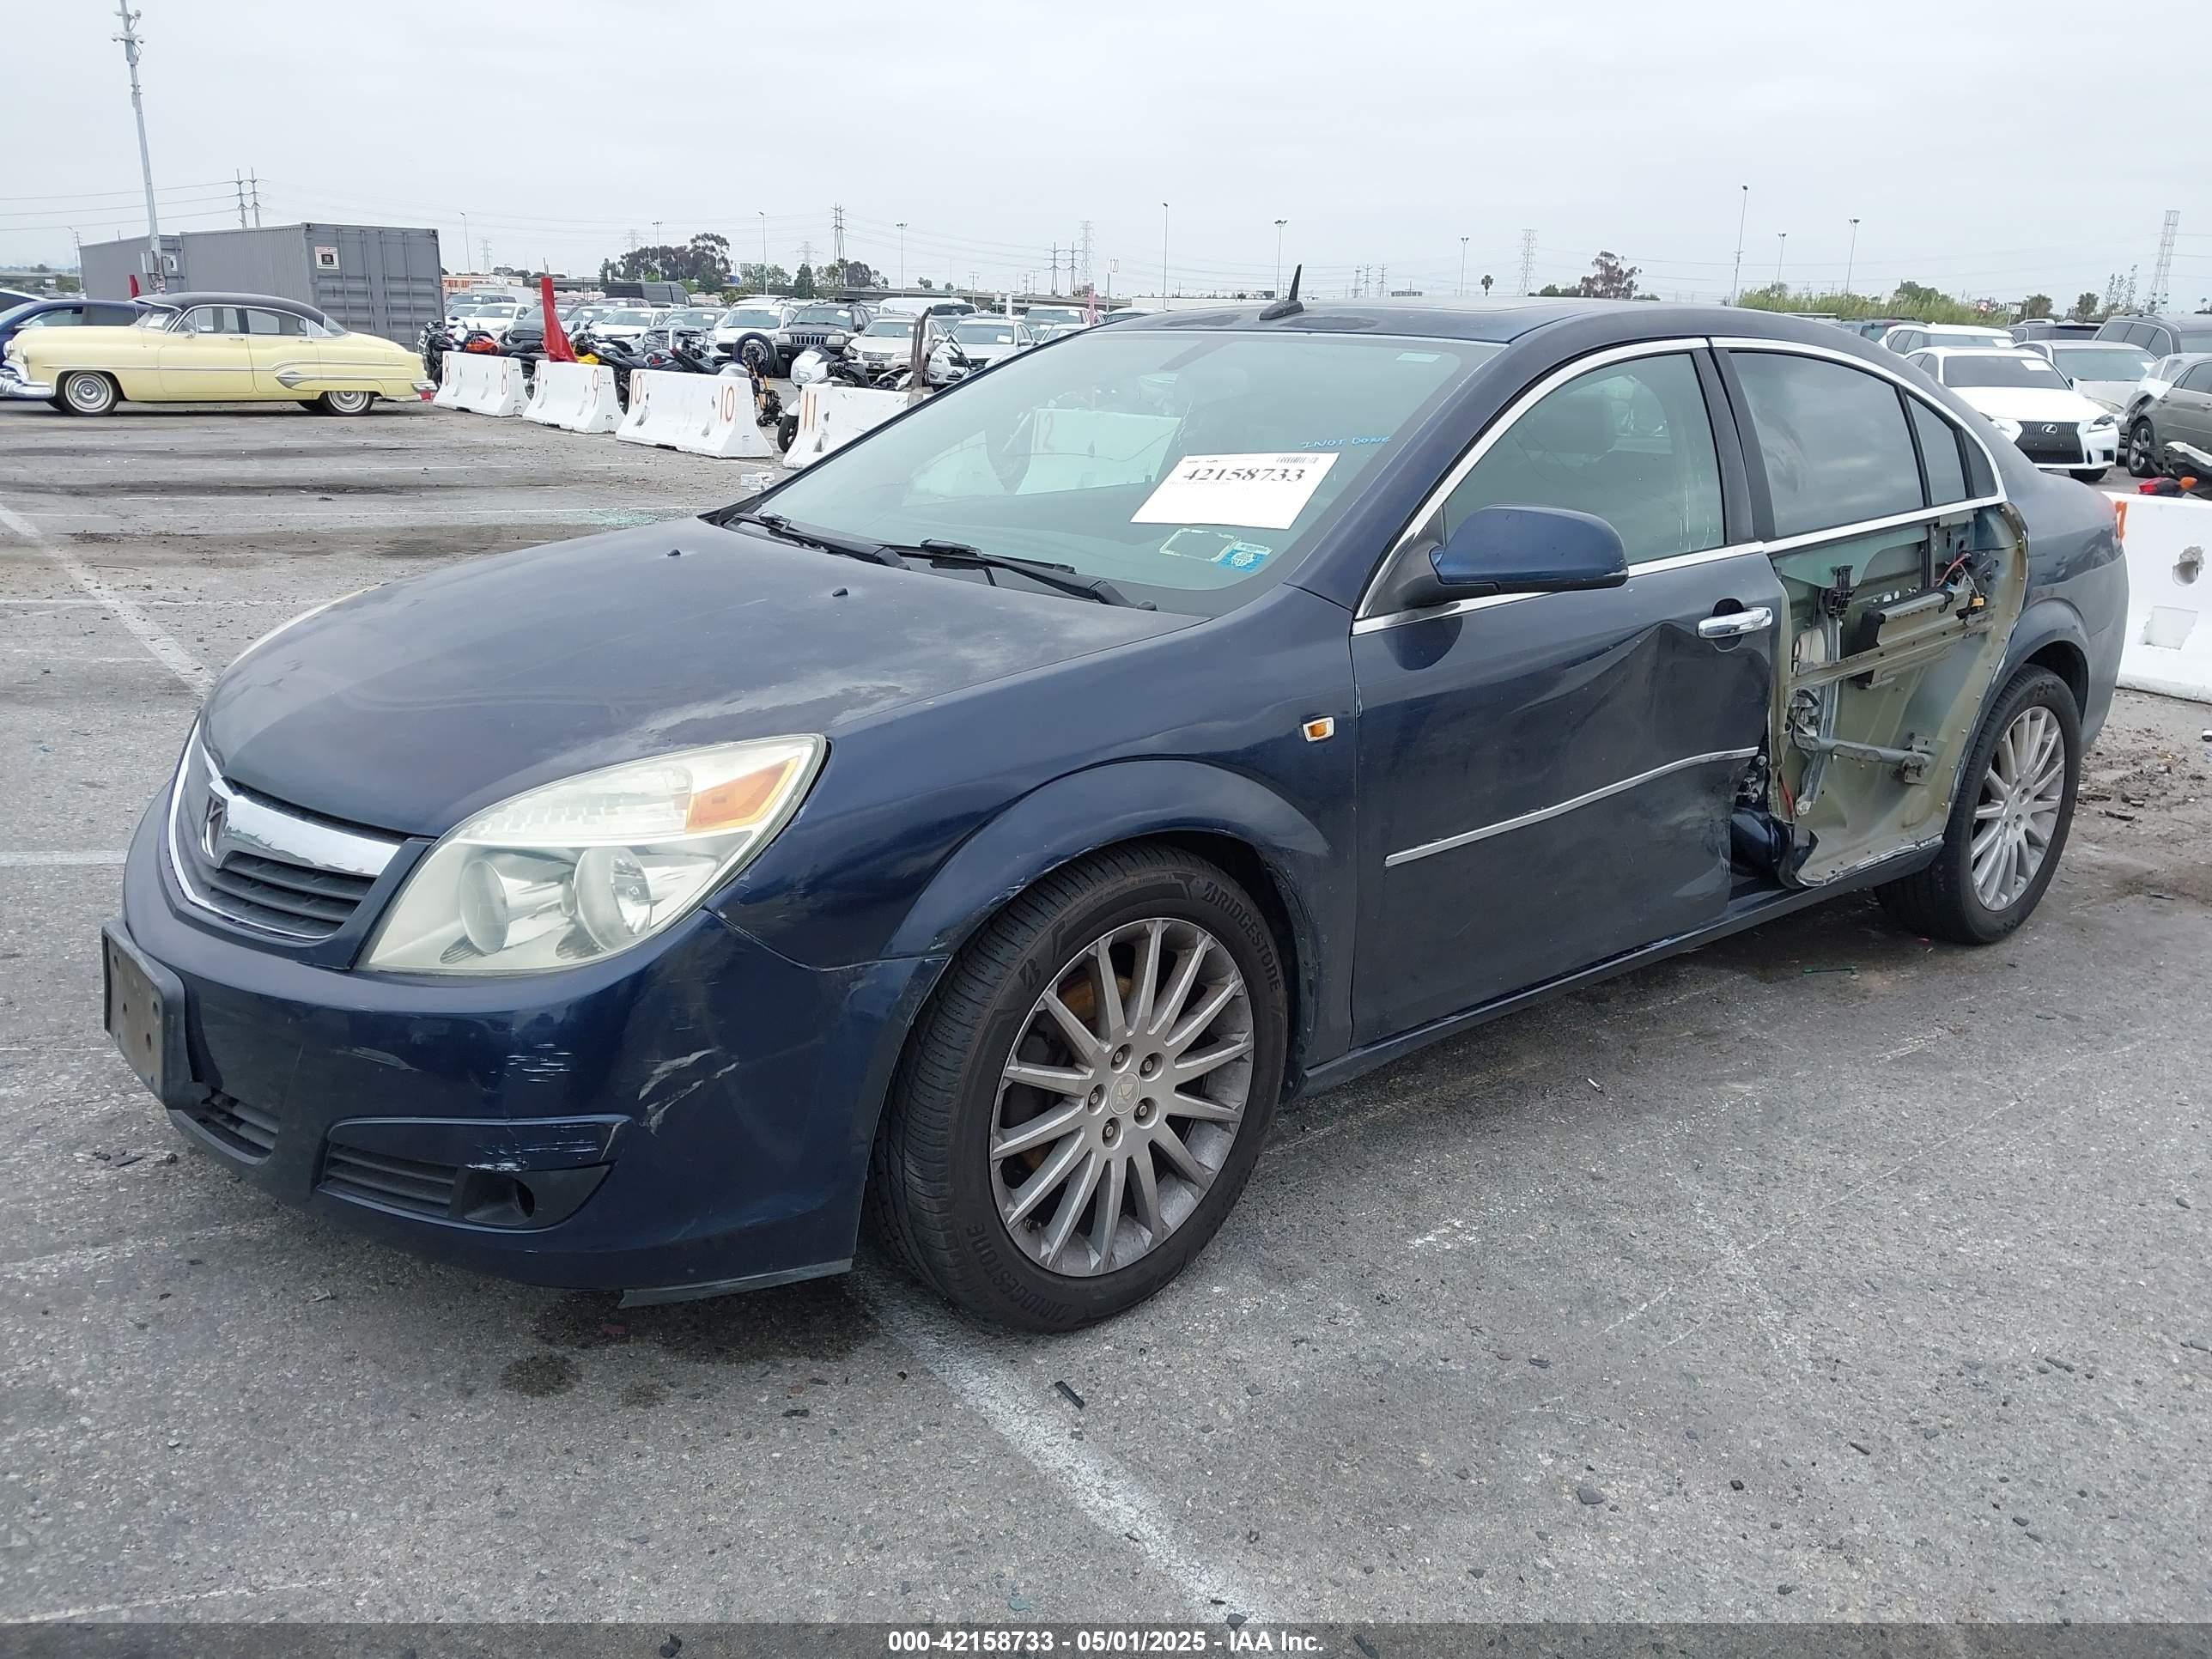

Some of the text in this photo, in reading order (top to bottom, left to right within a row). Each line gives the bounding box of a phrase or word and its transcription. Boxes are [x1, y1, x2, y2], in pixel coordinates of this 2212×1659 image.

[501, 359, 508, 396] 8
[592, 368, 600, 408] 9
[630, 373, 643, 406] 10
[720, 385, 735, 425] 10
[1182, 467, 1306, 481] 42158733
[1202, 881, 1282, 991] BRIDGESTONE
